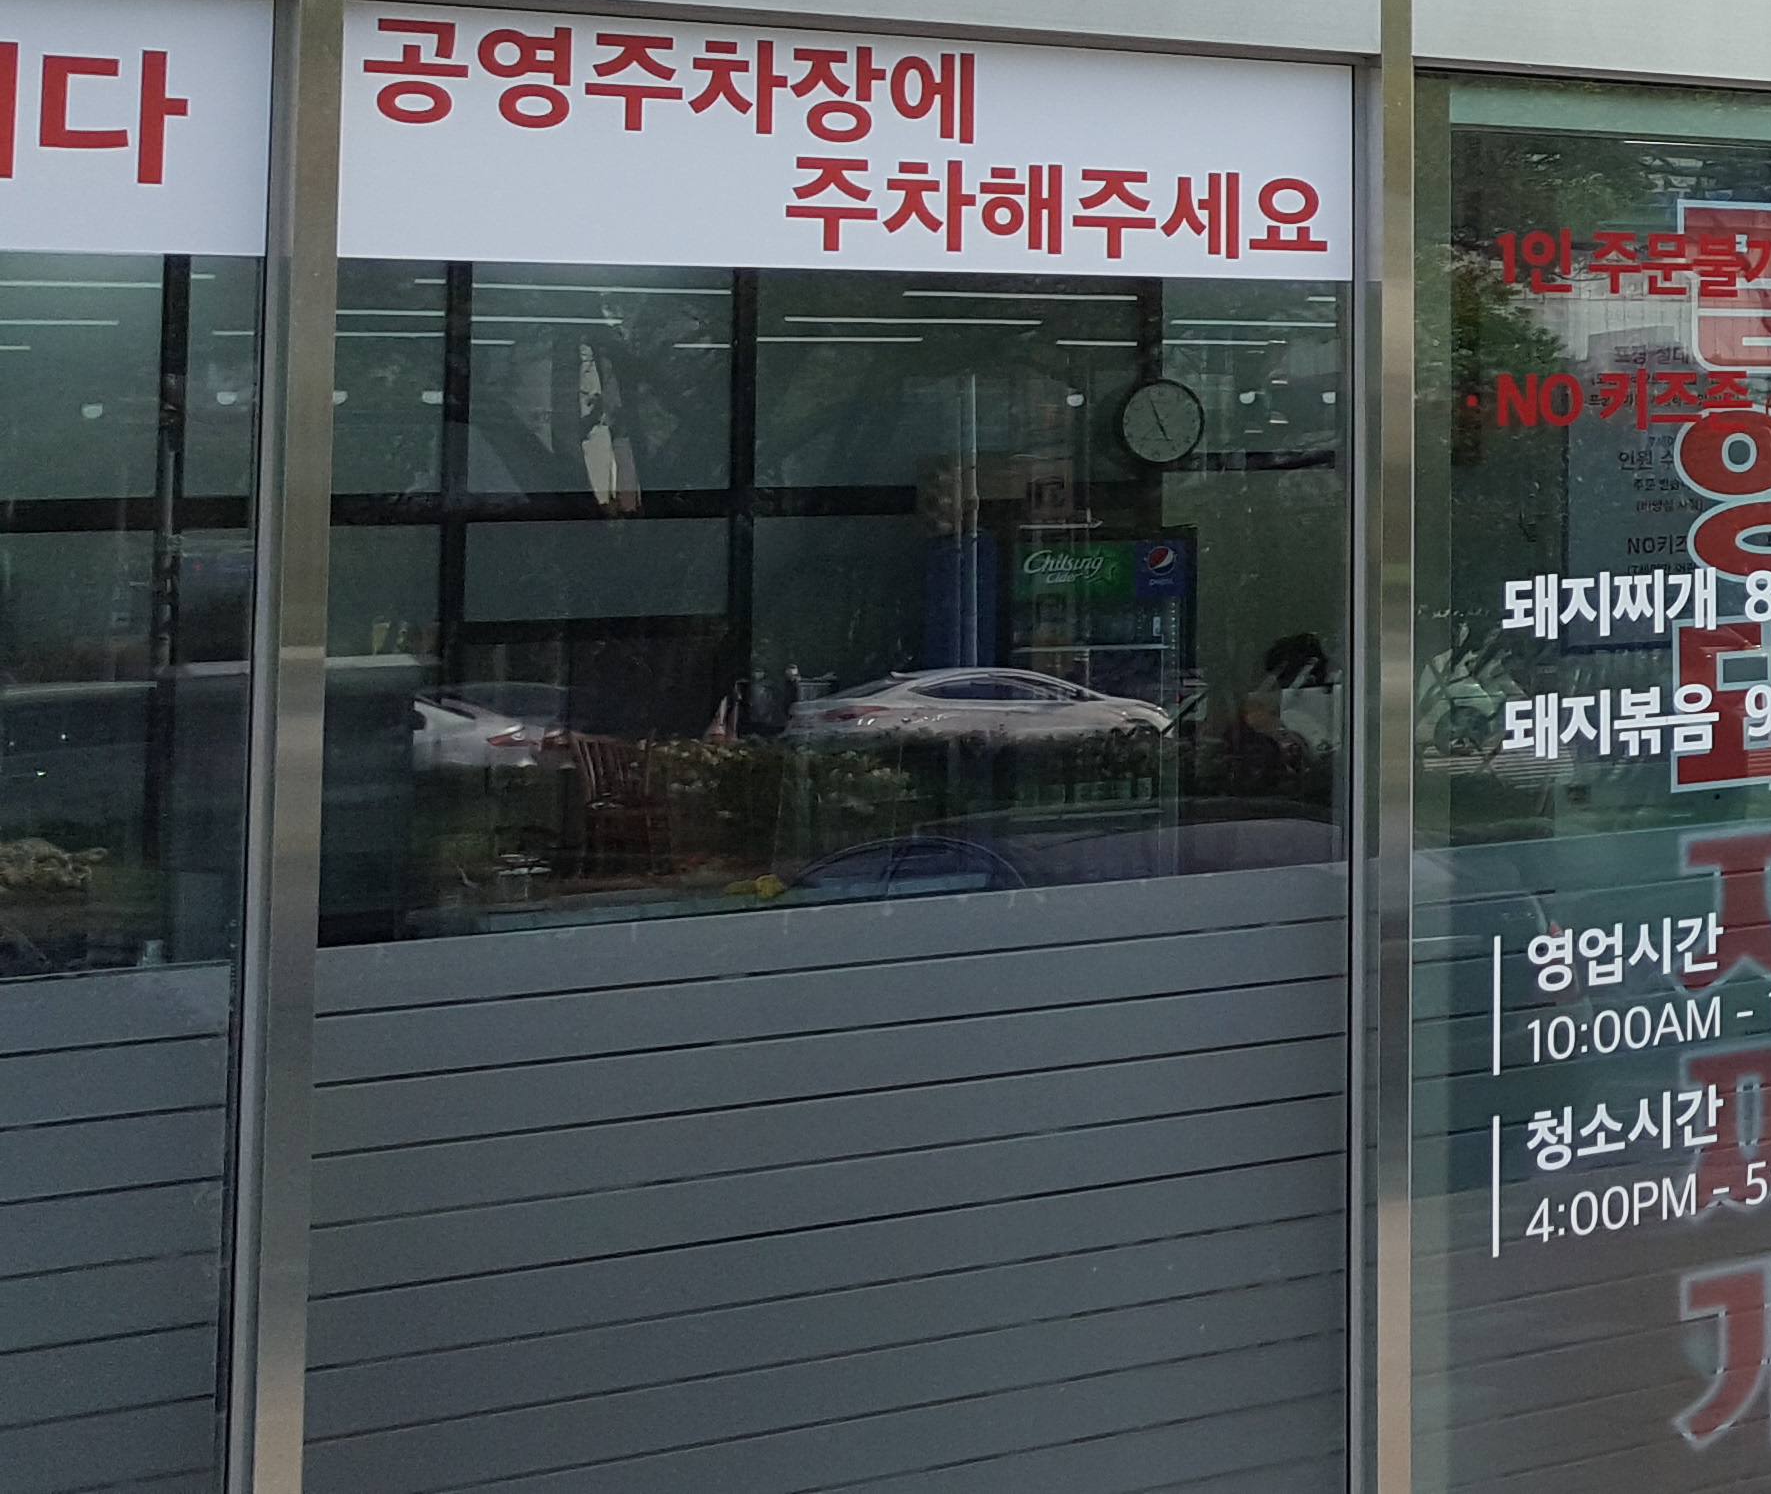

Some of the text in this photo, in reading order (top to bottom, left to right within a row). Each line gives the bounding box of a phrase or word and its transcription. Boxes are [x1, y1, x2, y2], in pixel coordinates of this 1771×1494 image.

[362, 17, 976, 144] 공영주차장에
[785, 157, 1328, 259] 주차해주세요
[1498, 385, 1582, 427] NO
[1599, 368, 1755, 432] 키즈존
[1501, 566, 1719, 640] 돼지찌개
[1502, 682, 1720, 760] 돼지볶음
[1526, 912, 1725, 993] 영업시간
[1526, 996, 1721, 1064] 10:00AM
[1526, 1084, 1724, 1173] 청소시간
[1526, 1173, 1699, 1247] 4:00PM
